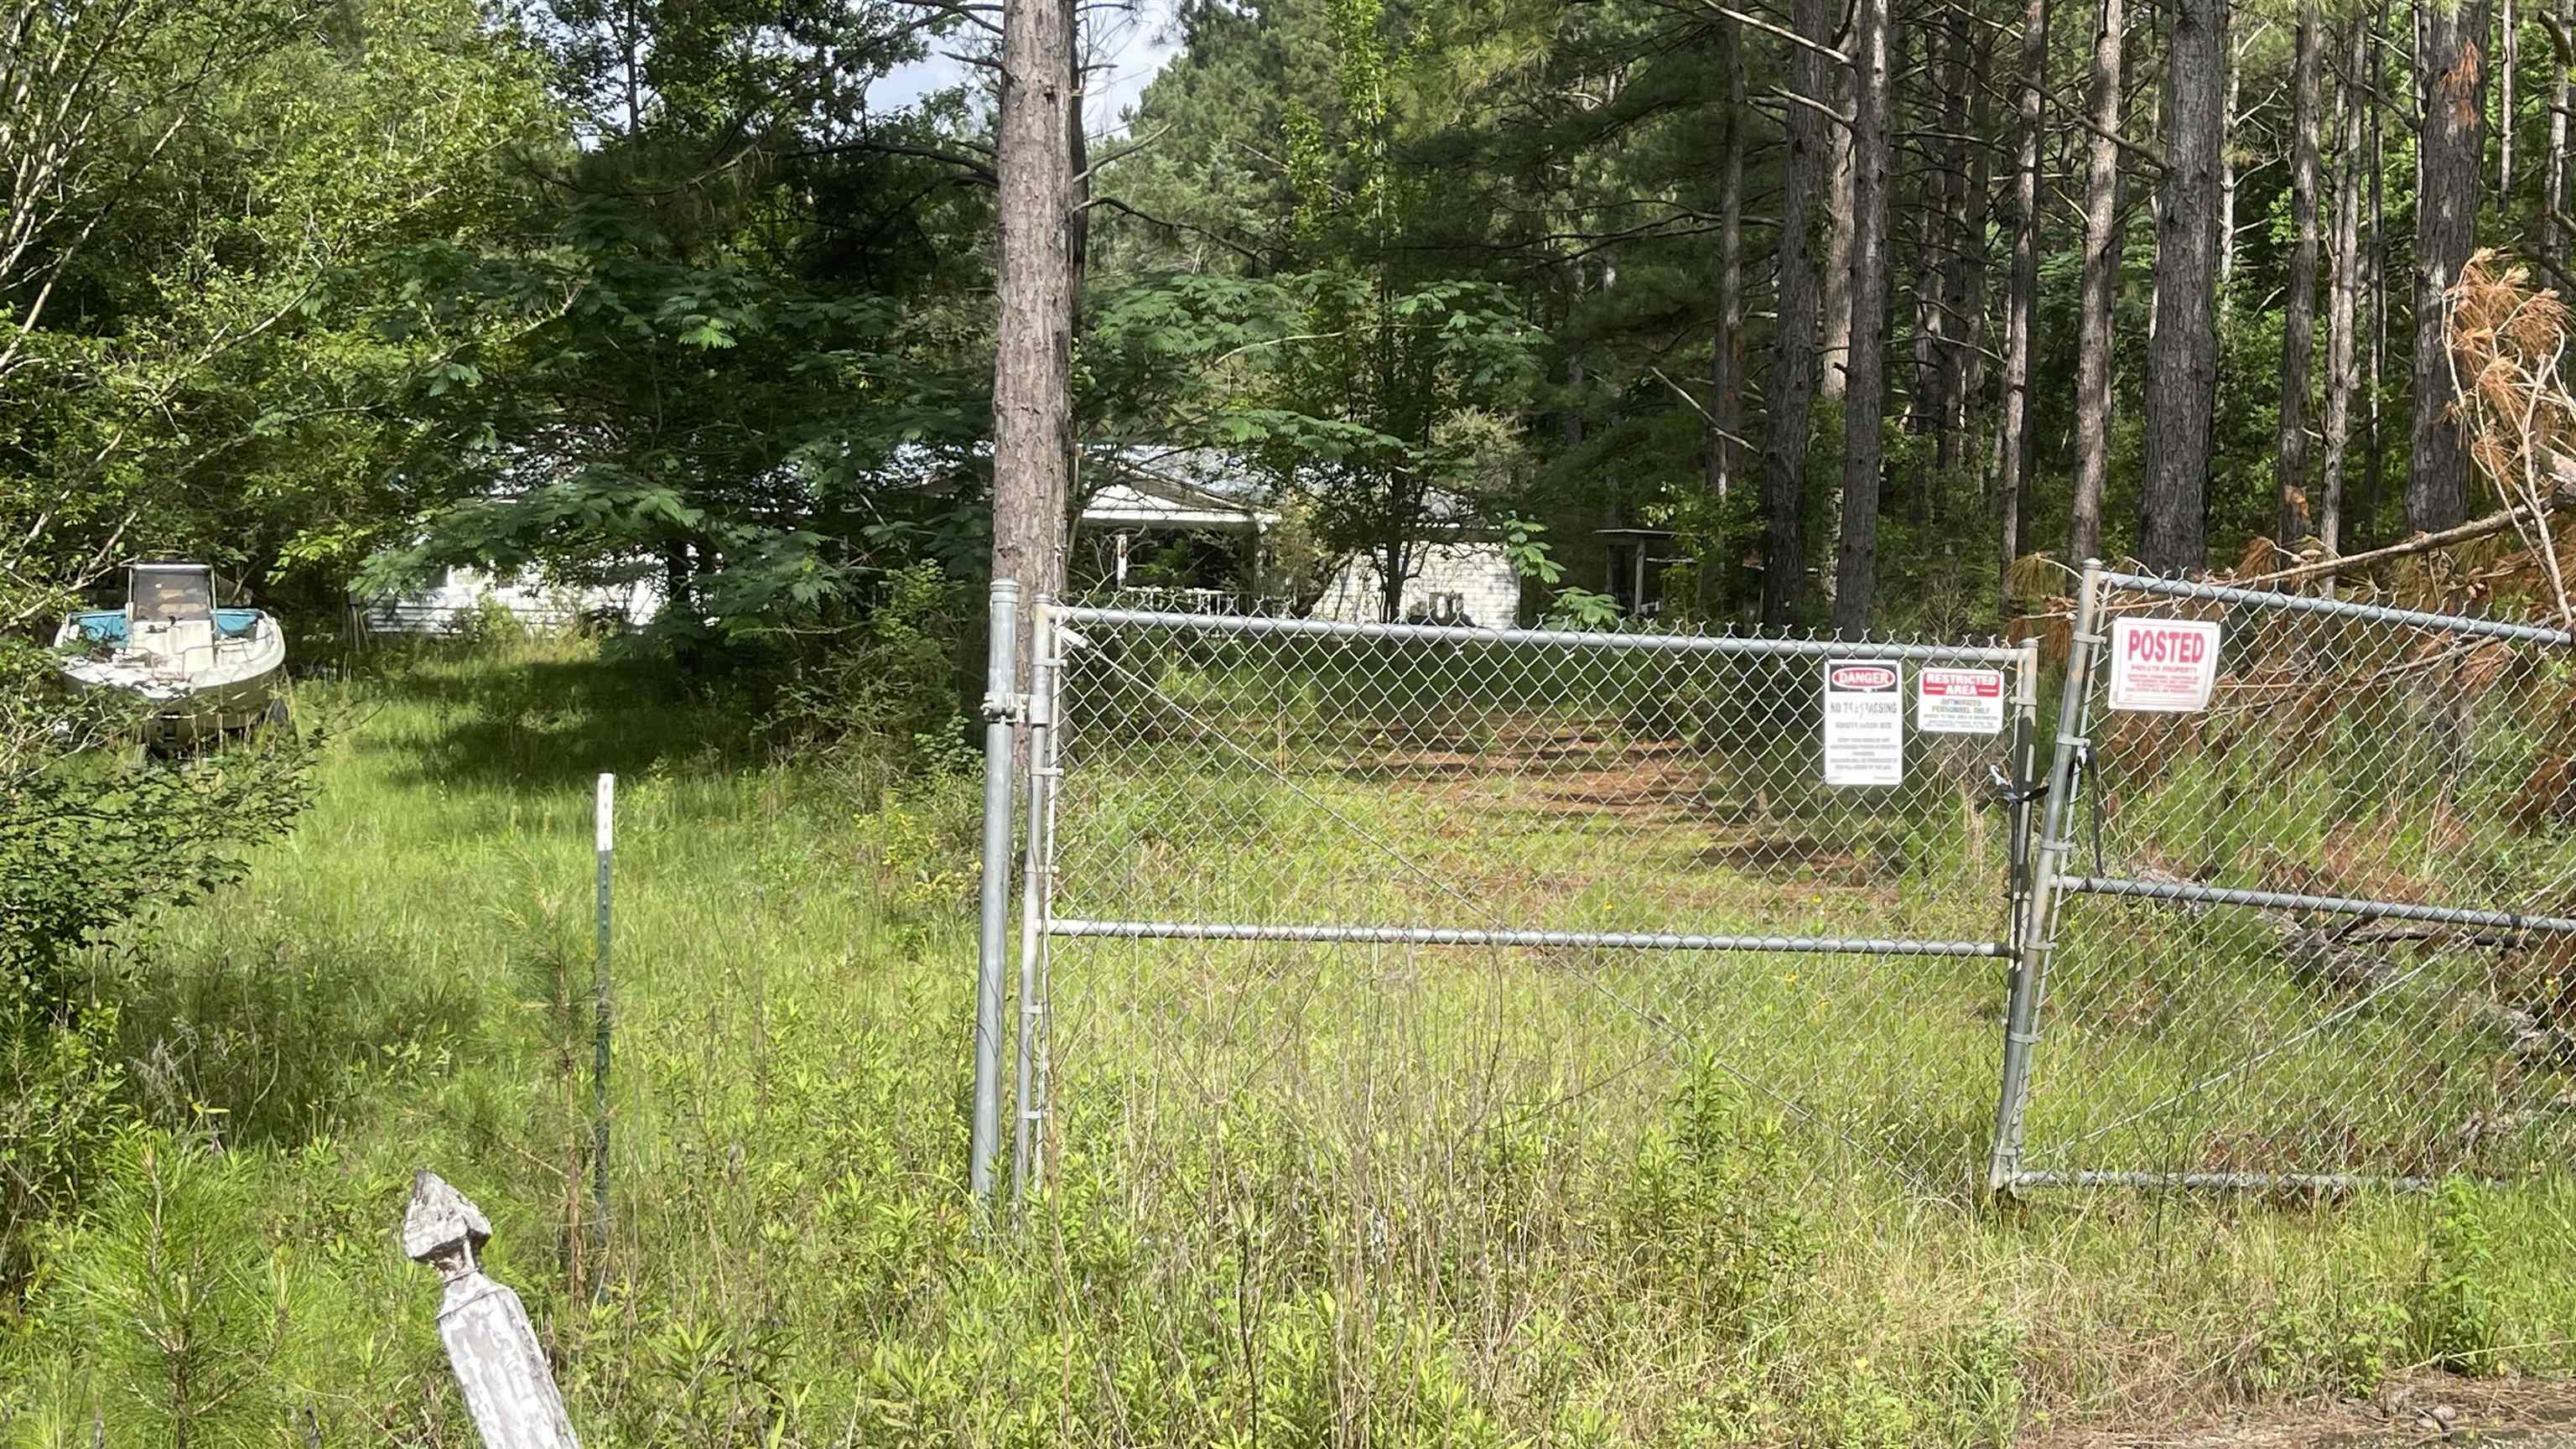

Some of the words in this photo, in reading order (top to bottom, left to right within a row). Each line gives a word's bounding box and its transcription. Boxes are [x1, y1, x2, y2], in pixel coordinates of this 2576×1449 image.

[2127, 630, 2205, 663] POSTED
[1838, 671, 1889, 685] DANGER
[1925, 673, 1997, 685] RESTRICTED
[1945, 684, 1978, 696] AREA
[1830, 703, 1841, 714] NO
